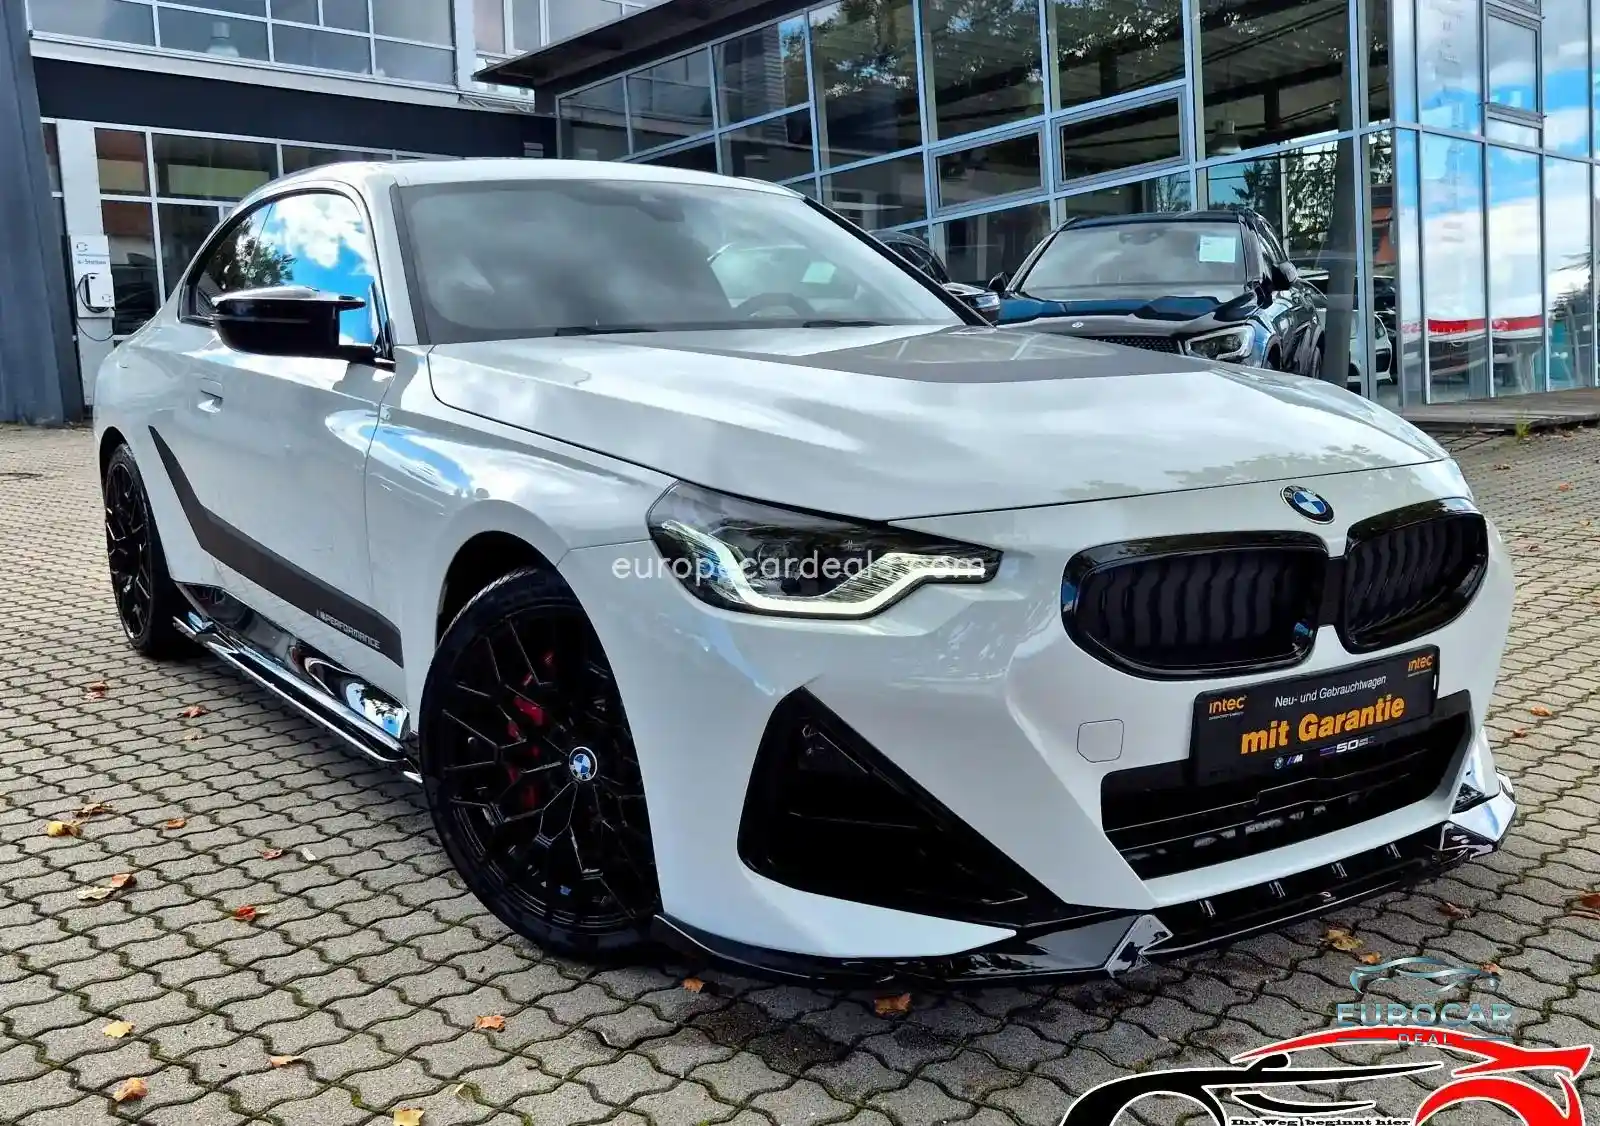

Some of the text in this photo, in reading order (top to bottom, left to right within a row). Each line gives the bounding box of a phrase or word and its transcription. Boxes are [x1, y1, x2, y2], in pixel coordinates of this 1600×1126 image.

[324, 612, 381, 650] PERFORMANCE
[1408, 655, 1433, 672] intec
[1208, 697, 1245, 714] intec
[1274, 674, 1387, 708] Neu- und Gebrauchtwagen
[1240, 694, 1405, 754] mit Garantie
